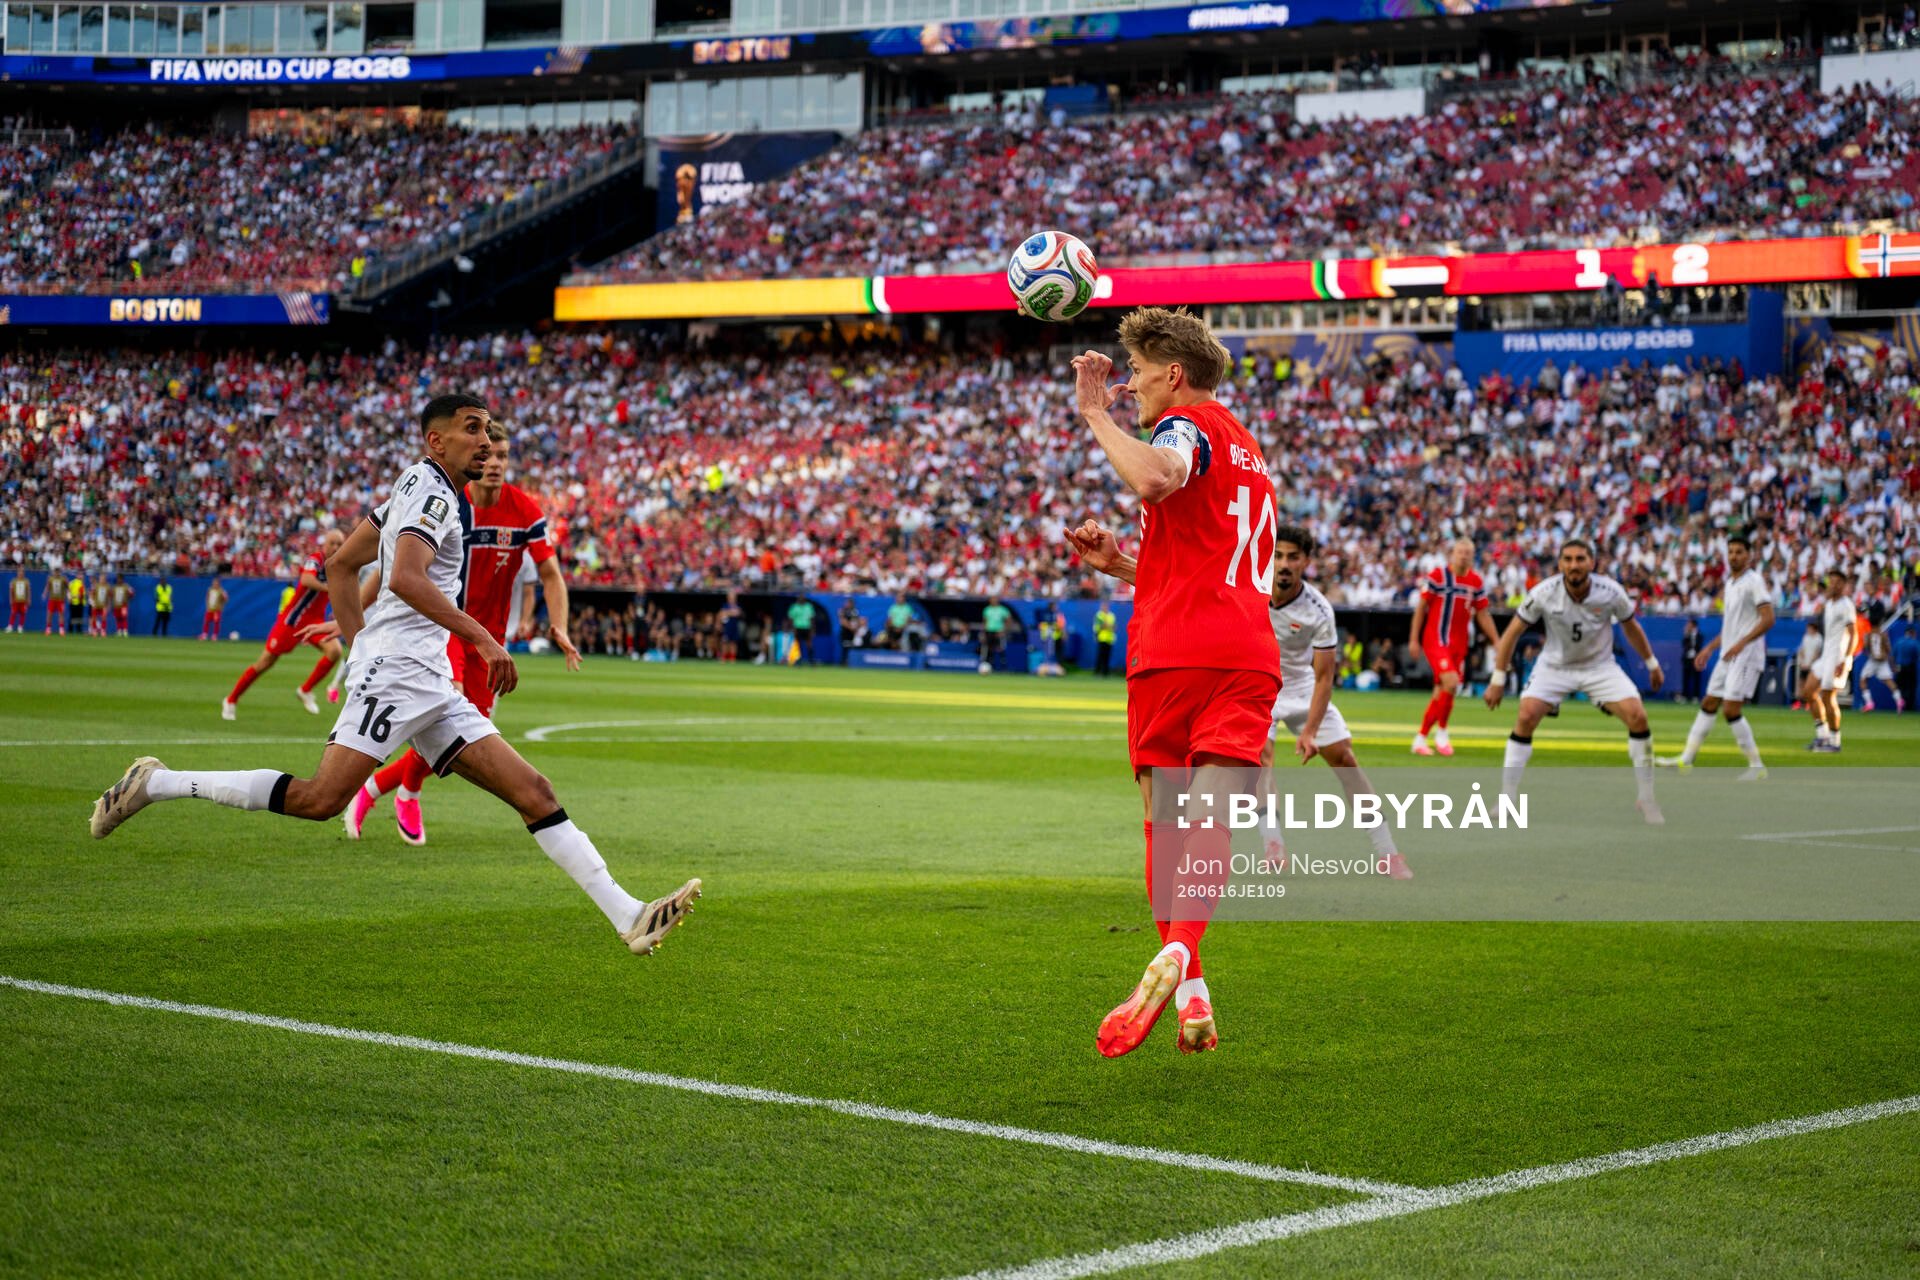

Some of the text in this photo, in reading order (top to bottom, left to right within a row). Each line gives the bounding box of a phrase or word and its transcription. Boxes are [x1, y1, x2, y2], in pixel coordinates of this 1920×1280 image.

[693, 37, 791, 64] BOSTON
[150, 56, 411, 81] FIFA WORLD CUP 2026
[701, 161, 745, 182] FIFA
[1575, 243, 1709, 289] 1 2
[110, 298, 202, 322] BOSTON
[1503, 327, 1695, 352] FIFA WORLD CUP 2026
[1225, 485, 1277, 596] 10
[494, 551, 510, 575] 7
[1571, 622, 1583, 642] 5
[358, 696, 397, 743] 16
